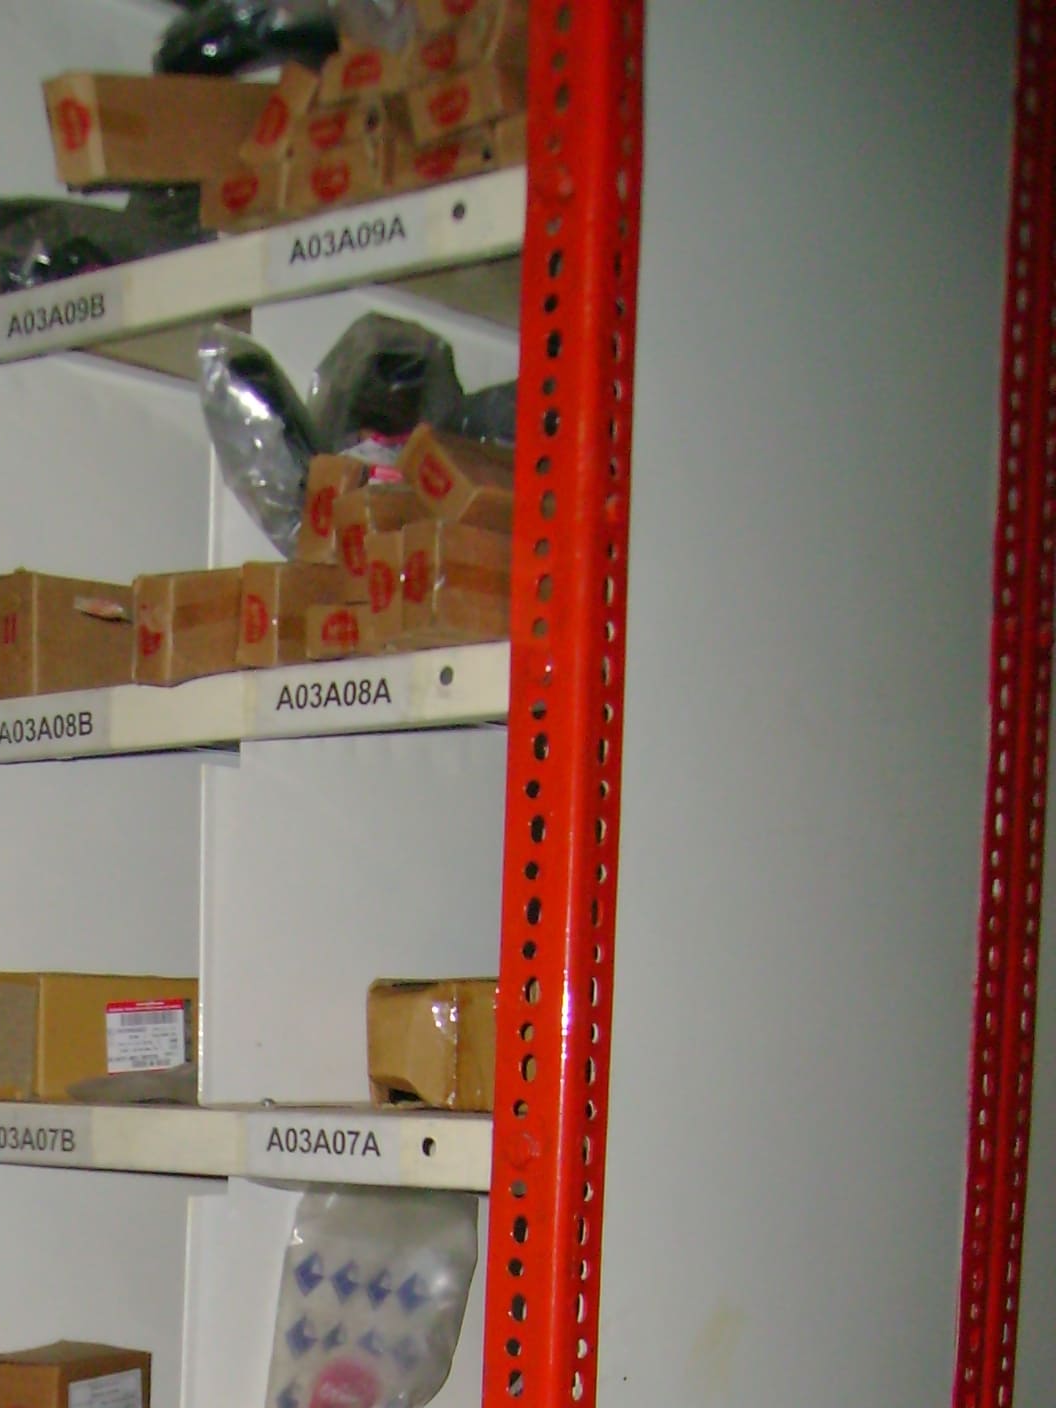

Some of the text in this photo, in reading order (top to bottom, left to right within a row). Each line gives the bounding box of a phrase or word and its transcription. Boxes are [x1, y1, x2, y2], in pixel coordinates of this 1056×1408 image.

[289, 221, 407, 264] A03A09A
[6, 294, 107, 338] A03A09B
[276, 677, 392, 711] A03A08A
[265, 1126, 382, 1158] A03A07A
